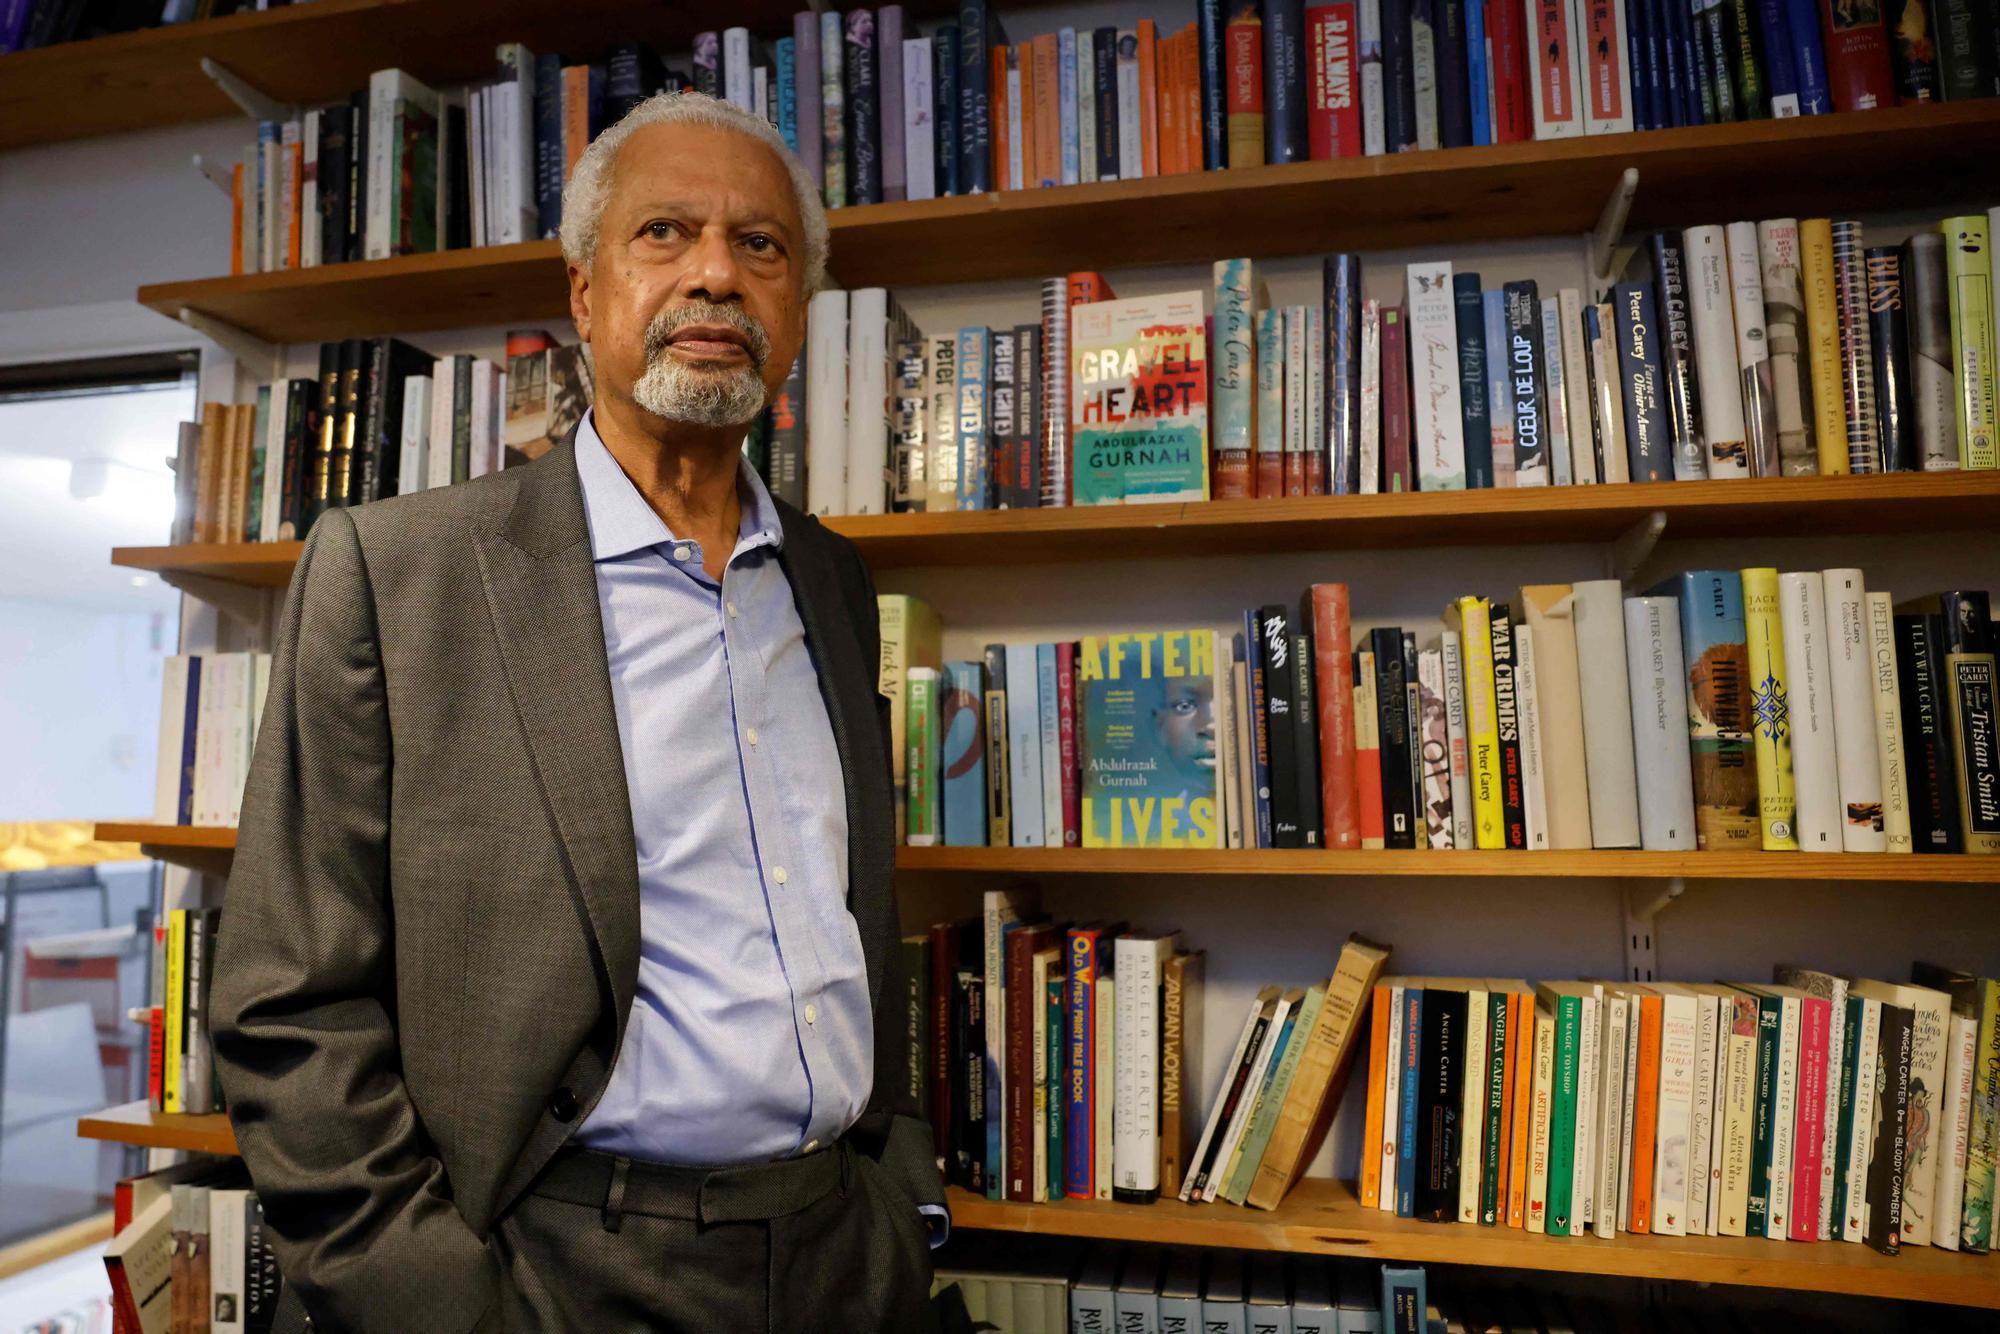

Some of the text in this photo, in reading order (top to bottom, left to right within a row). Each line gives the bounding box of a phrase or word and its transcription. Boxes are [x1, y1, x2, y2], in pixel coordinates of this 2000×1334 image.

[961, 7, 981, 66] CATS
[1274, 32, 1283, 53] CITY
[1275, 54, 1284, 67] OF
[1285, 36, 1295, 76] LONDON
[1709, 13, 1730, 107] TOWARDS MELLBREAK
[1325, 20, 1350, 109] RAILWAYS
[1740, 35, 1757, 92] MELLBREAK
[1276, 69, 1285, 111] LONDON
[962, 89, 973, 154] BOYLAN
[975, 93, 987, 146] CLARE
[855, 145, 874, 193] Brown
[1711, 255, 1721, 294] Peter Carey
[1867, 255, 1901, 312] BLISS
[1661, 248, 1687, 351] PETER CAREY
[1217, 287, 1250, 391] Peter Carey
[1628, 291, 1647, 360] Peter Carey
[1080, 343, 1200, 385] GRAVEL
[1644, 364, 1657, 409] Parrot and
[1968, 351, 1979, 422] PETER CAREY
[1082, 381, 1196, 424] HEART
[1513, 334, 1538, 447] CŒUR DE LOUP
[1633, 373, 1648, 408] Olivier
[1089, 447, 1191, 468] GURNAH
[1092, 434, 1184, 449] ABDULRAZAK
[1636, 415, 1650, 456] America
[1800, 583, 1810, 603] PETER
[1801, 604, 1810, 627] CAREY
[1804, 633, 1812, 644] The
[1841, 601, 1854, 661] Collected Stories
[1851, 601, 1862, 644] Peter Carey
[882, 640, 898, 673] Jack
[1081, 628, 1213, 681] AFTER
[1649, 606, 1668, 730] PETER CAREY Illywhacker
[1711, 578, 1744, 769] CAREY ILLYWHACKER
[1806, 672, 1814, 684] Life
[1959, 665, 1989, 674] PETER
[1298, 639, 1309, 723] PETER CAREY BLISS
[1446, 644, 1462, 728] PETER CAREY
[1808, 693, 1817, 713] Tristan
[1911, 624, 1934, 736] ILLYWHACKER
[1959, 674, 1989, 684] CAREY
[1060, 672, 1072, 778] CAREY
[1491, 617, 1519, 808] WAR CRIMES PETER CAREY
[1810, 714, 1819, 733] Smith
[1873, 601, 1902, 812] PETER CAREY THE TAX INSPECTOR
[1088, 757, 1158, 772] Abdulrazak
[1099, 773, 1147, 786] Gurnah
[1478, 744, 1493, 802] Peter Carey
[1969, 710, 1997, 821] Tristan Smith
[1081, 796, 1217, 849] LIVES
[1073, 936, 1090, 967] OLD
[1073, 1010, 1084, 1040] FAIRY
[1125, 954, 1133, 1135] BURNING YOUR BOATS
[1138, 954, 1151, 1141] ANGELA CARTER
[1163, 975, 1179, 1104] SADEIAN WOMAN
[1286, 1030, 1308, 1059] DARK
[1441, 1013, 1450, 1052] ANGELA
[1469, 1000, 1481, 1077] NOTHING SACRED
[1494, 1001, 1505, 1052] ANGELA
[1563, 1001, 1573, 1094] THE MAGIC TOYSHOP
[1701, 1007, 1712, 1053] ANGELA
[1899, 1026, 1911, 1064] ANGELA
[939, 1040, 947, 1079] CARTER
[1074, 1043, 1084, 1067] TALE
[1439, 1057, 1449, 1094] CARTER
[1732, 1047, 1744, 1104] Wicked Women
[1073, 1069, 1084, 1103] BOOK
[1492, 1057, 1504, 1108] CARTER
[1534, 1026, 1550, 1177] Angela Carter ARTIFICIAL FIRE
[1698, 1058, 1709, 1105] CARTER
[1776, 1004, 1794, 1204] ANGELA CARTER NOTHING SACRED
[1897, 1065, 1908, 1105] CARTER
[1051, 1085, 1060, 1138] Angela Carter
[1444, 1106, 1454, 1123] The
[1852, 1007, 1876, 1208] ANGELA CARTER NOTHING SACRED
[1727, 1118, 1738, 1192] ANGELA CARTER
[1735, 1135, 1745, 1176] Edited by
[1893, 1136, 1904, 1172] BLOODY
[1691, 1164, 1705, 1203] Deleted
[1890, 1175, 1902, 1225] CHAMBER
[250, 1224, 261, 1314] SOLUTION
